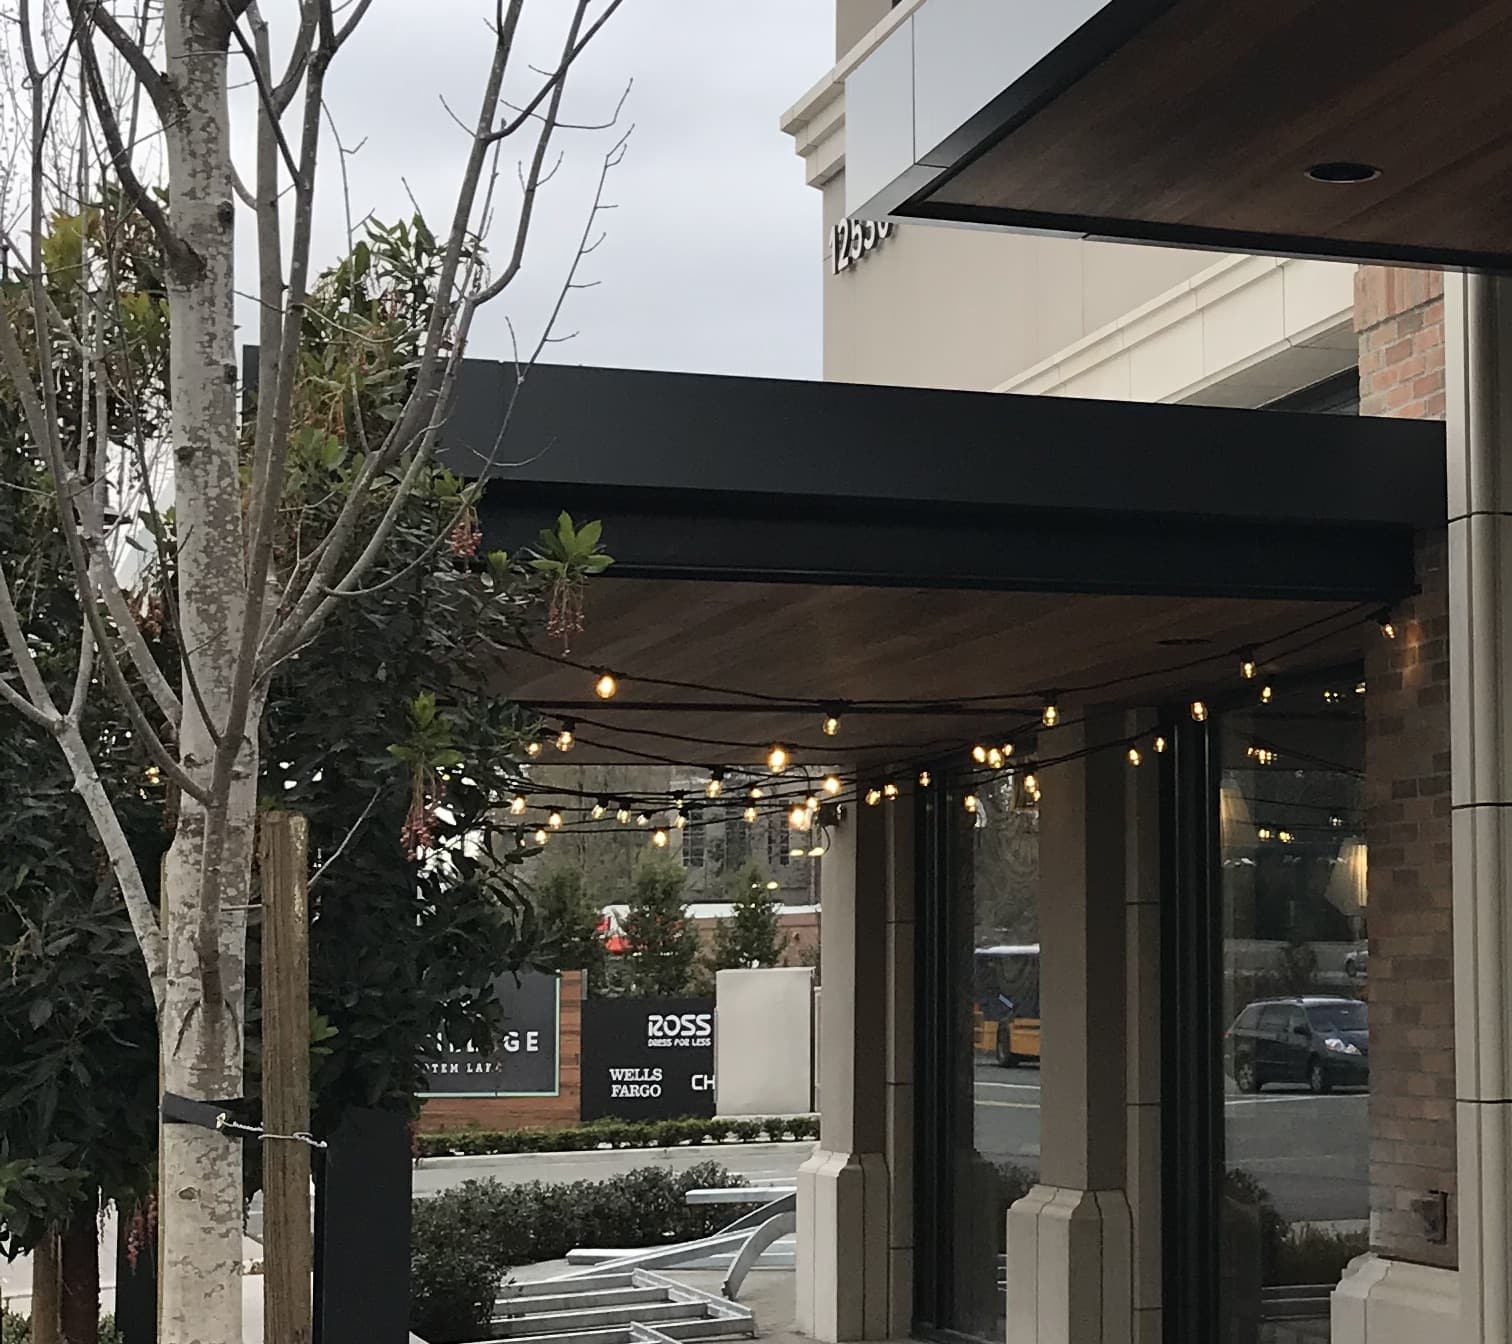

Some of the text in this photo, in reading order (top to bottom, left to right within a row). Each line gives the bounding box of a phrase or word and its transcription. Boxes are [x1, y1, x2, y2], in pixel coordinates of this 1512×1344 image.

[648, 1014, 711, 1036] ROSS
[691, 1038, 711, 1046] LESS
[609, 1068, 662, 1081] WELLS
[611, 1084, 661, 1097] FARGO
